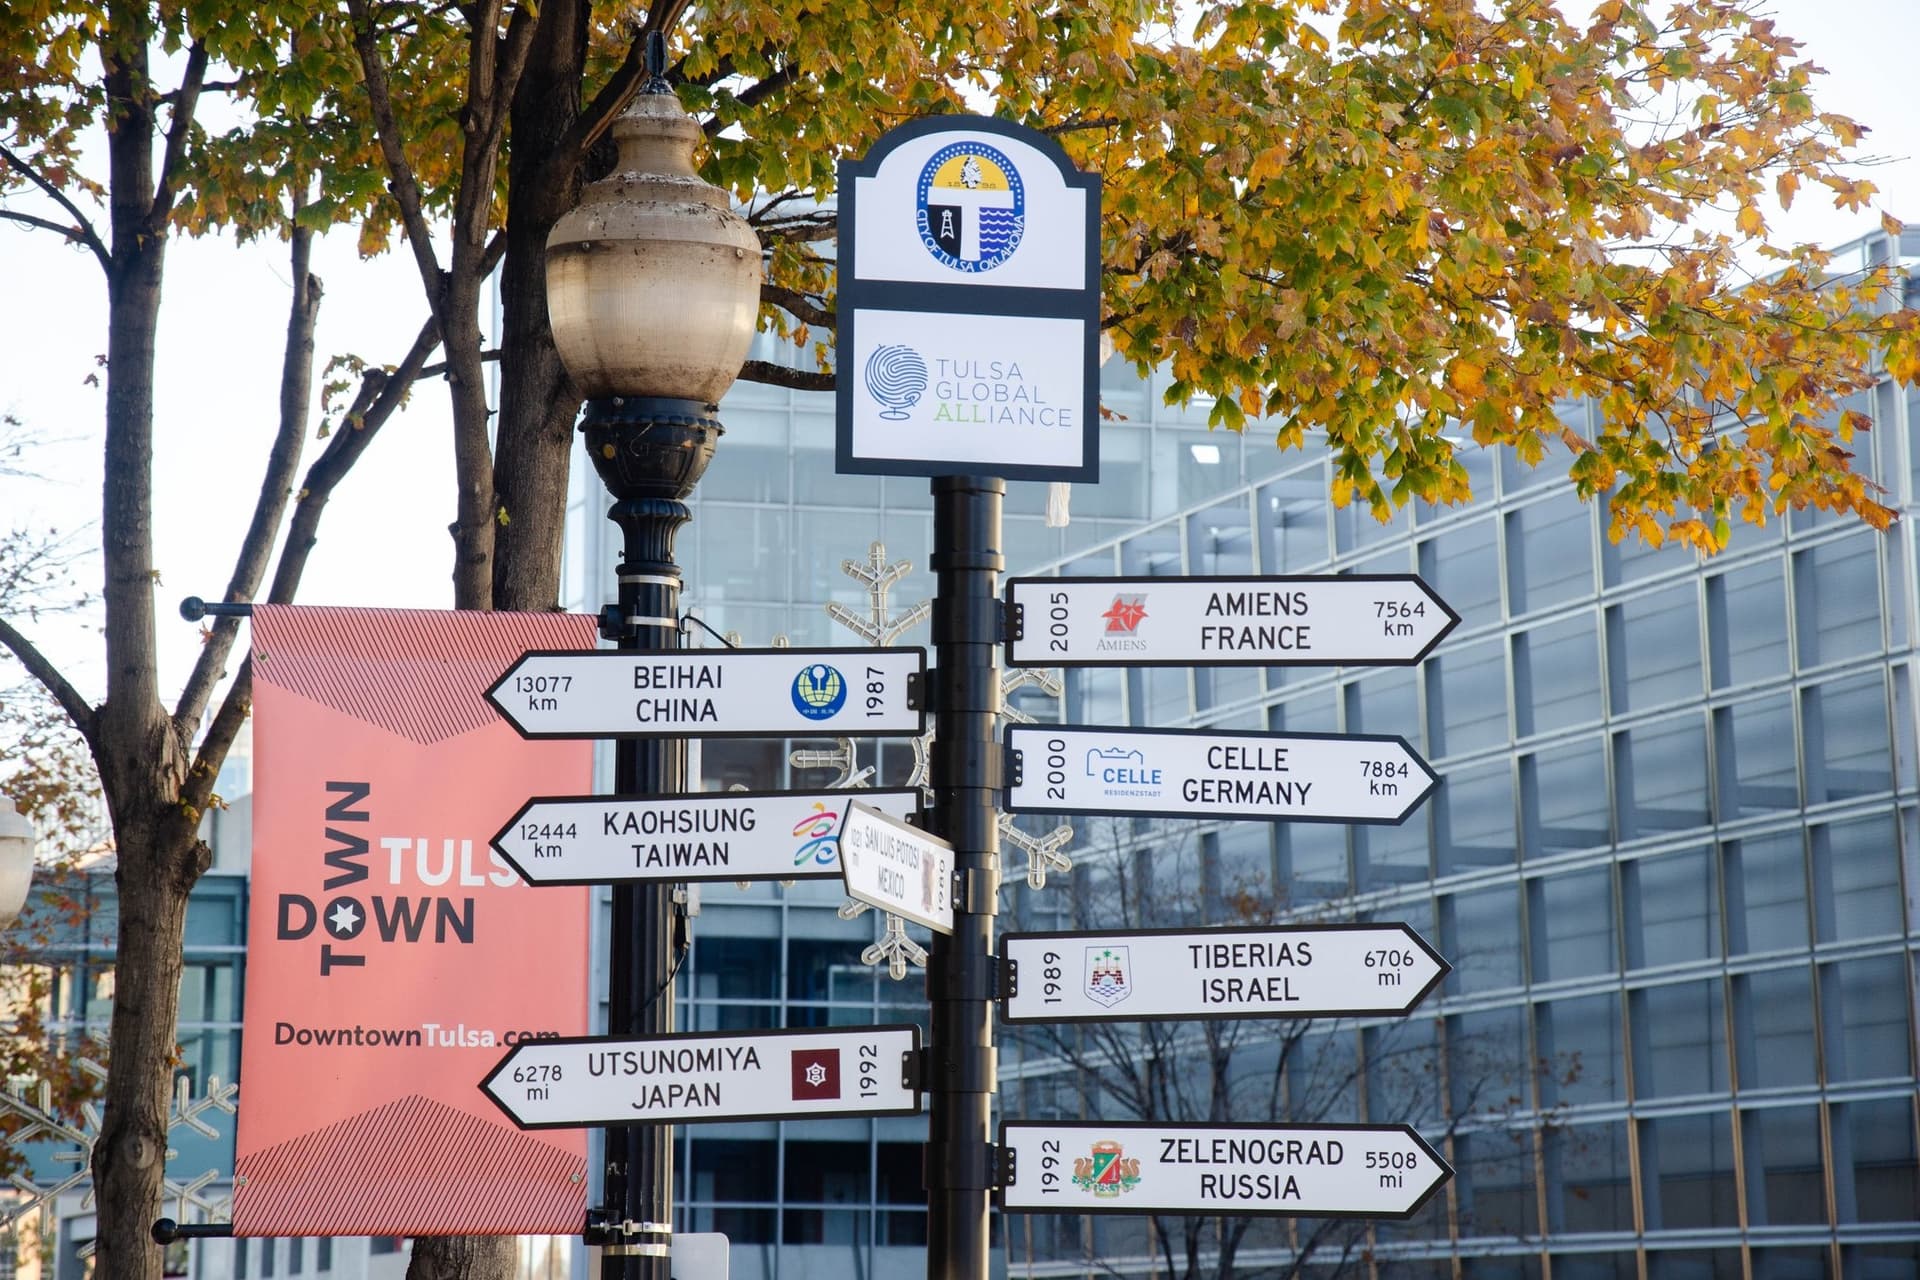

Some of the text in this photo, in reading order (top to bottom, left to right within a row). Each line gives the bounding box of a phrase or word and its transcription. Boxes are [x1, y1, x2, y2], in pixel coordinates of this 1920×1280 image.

[917, 209, 1024, 272] CITY OF TULSA OKLAHOMA
[936, 359, 1023, 381] TULSA
[936, 382, 1046, 404] GLOBAL
[934, 403, 1072, 427] ALLIANCE
[1206, 592, 1308, 616] AMIENS
[1374, 601, 1426, 618] 7564
[1050, 593, 1068, 651] 2005
[1384, 620, 1414, 637] km
[1202, 626, 1311, 650] FRANCE
[515, 676, 572, 693] 13077
[634, 665, 722, 690] BEIHAI
[529, 695, 558, 711] km
[866, 667, 884, 717] 1987
[636, 699, 719, 722] CHINA
[1047, 739, 1066, 799] 2000
[1207, 746, 1289, 772] CELLE
[1360, 761, 1409, 778] 7884
[1103, 768, 1162, 784] CELLE
[1369, 780, 1398, 796] km
[1104, 789, 1161, 797] RESIDENZSTADT
[1183, 779, 1313, 806] GERMANY
[521, 823, 577, 841] 12444
[603, 808, 756, 835] KAOHSIUNG
[534, 842, 562, 858] km
[632, 842, 729, 868] TAIWAN
[865, 825, 919, 870] SAN LUIS POTOSI
[380, 837, 530, 887] TULS
[878, 864, 905, 900] MEXICO
[1188, 942, 1312, 968] TIBERIAS
[1364, 950, 1414, 968] 6706
[1043, 952, 1061, 1003] 1989
[1378, 969, 1401, 985] mi
[1202, 977, 1300, 1003] ISRAEL
[513, 1065, 563, 1083] 6278
[588, 1047, 761, 1077] UTSUNOMIYA
[859, 1045, 877, 1098] 1992
[526, 1084, 549, 1101] mi
[631, 1082, 721, 1109] JAPAN
[1160, 1139, 1344, 1166] ZELENOGRAD
[1365, 1152, 1417, 1169] 5508
[1041, 1140, 1060, 1194] 1992
[1200, 1174, 1301, 1200] RUSSIA
[1379, 1171, 1403, 1188] mi
